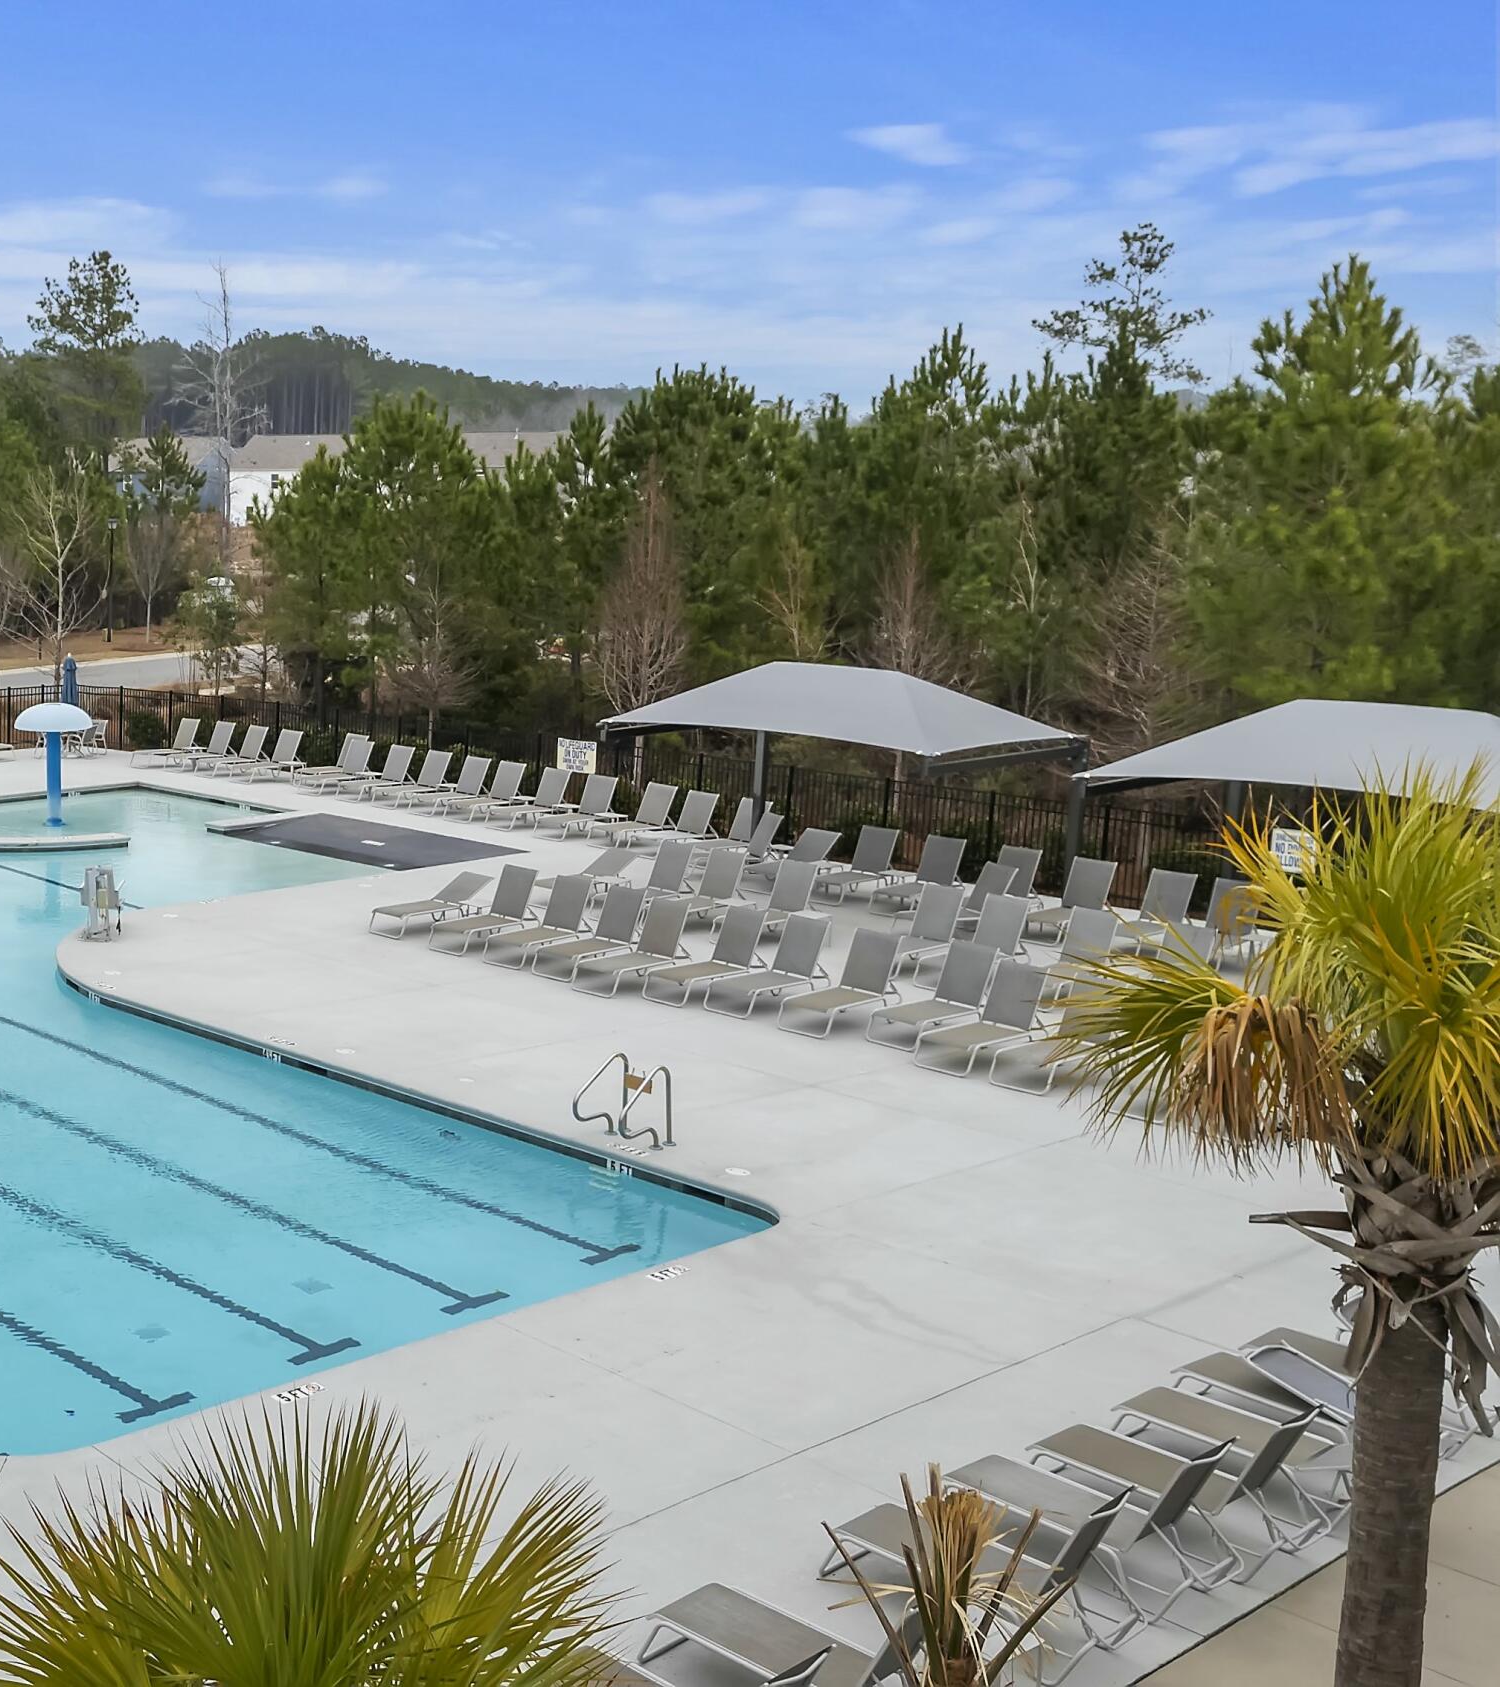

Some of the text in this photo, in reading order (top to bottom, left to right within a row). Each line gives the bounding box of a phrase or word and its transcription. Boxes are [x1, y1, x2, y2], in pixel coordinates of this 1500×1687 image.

[565, 740, 596, 752] LIFEGUARD
[572, 750, 587, 759] DUTY
[1275, 842, 1285, 854] NO
[620, 1163, 631, 1176] FT
[659, 1269, 678, 1279] FT
[277, 1388, 309, 1402] 5 FT
